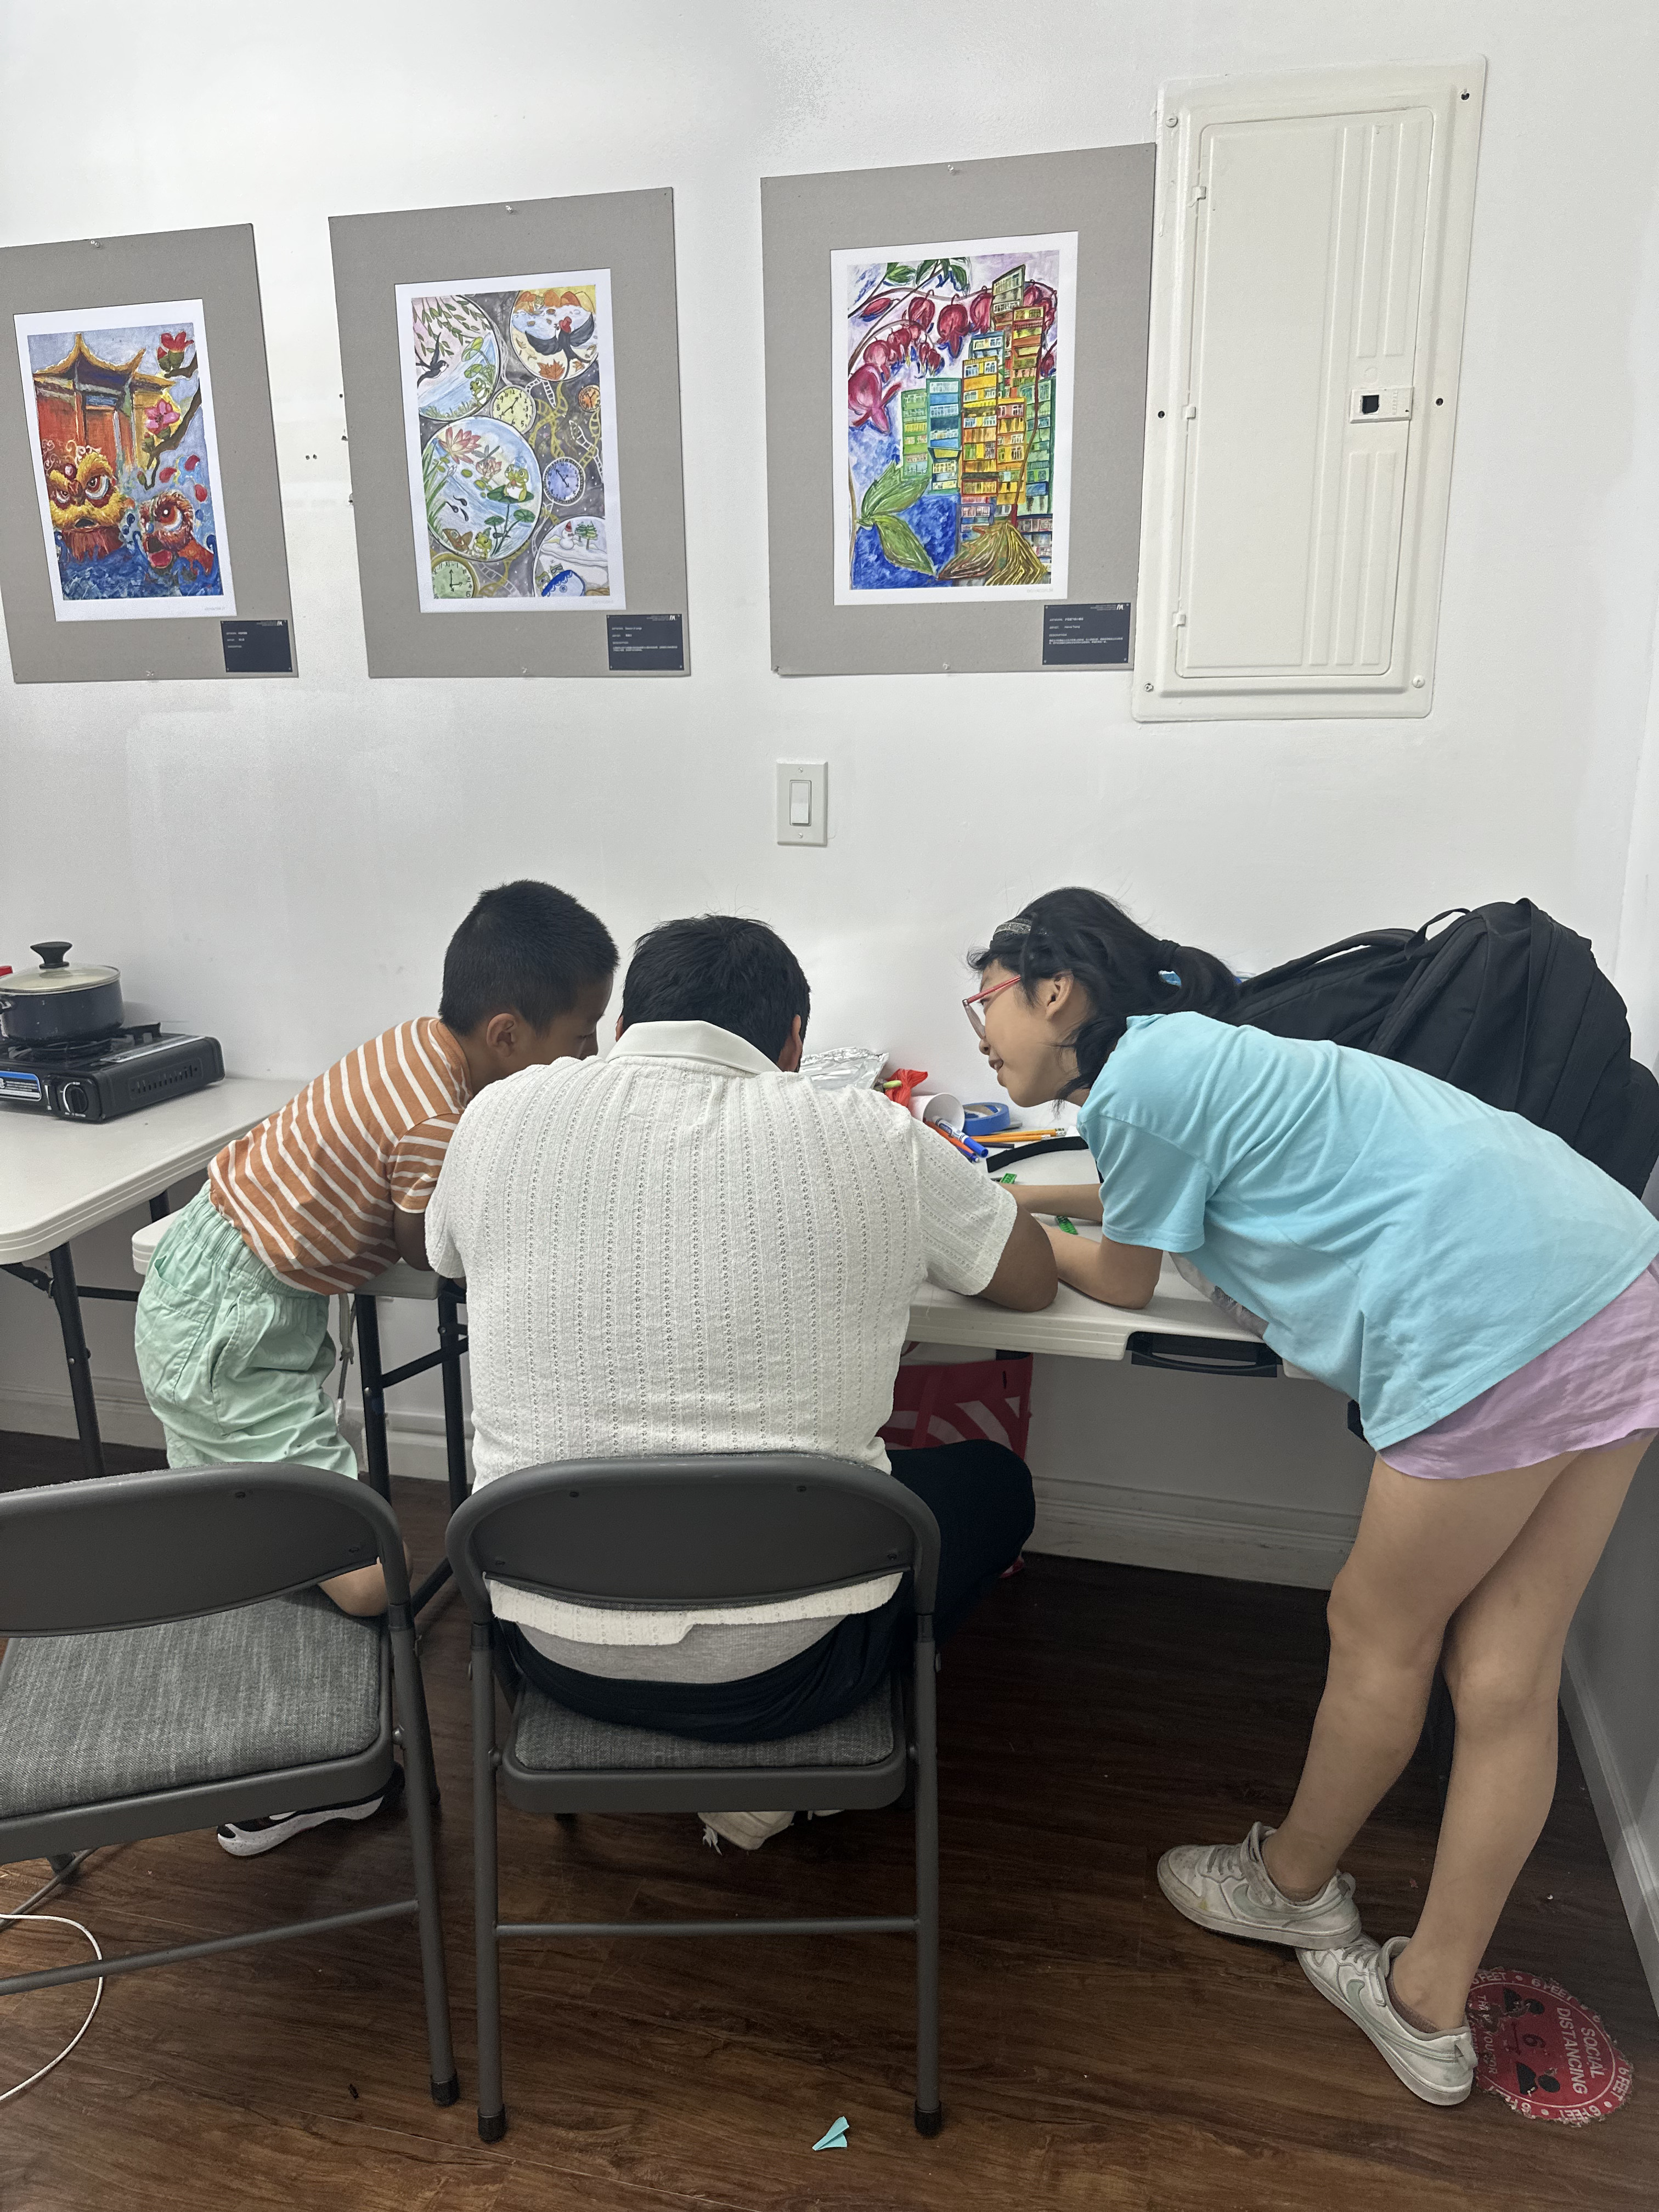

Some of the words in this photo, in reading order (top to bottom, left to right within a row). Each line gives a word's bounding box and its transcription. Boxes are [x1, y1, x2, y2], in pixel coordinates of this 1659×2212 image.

[1531, 1978, 1541, 1988] 6
[1483, 2030, 1495, 2052] YOU
[1556, 2007, 1588, 2094] DISTANCING
[1581, 2027, 1605, 2079] SOCIAL
[1618, 2067, 1629, 2075] 6
[1610, 2075, 1630, 2101] FEET
[1588, 2104, 1601, 2117] 6
